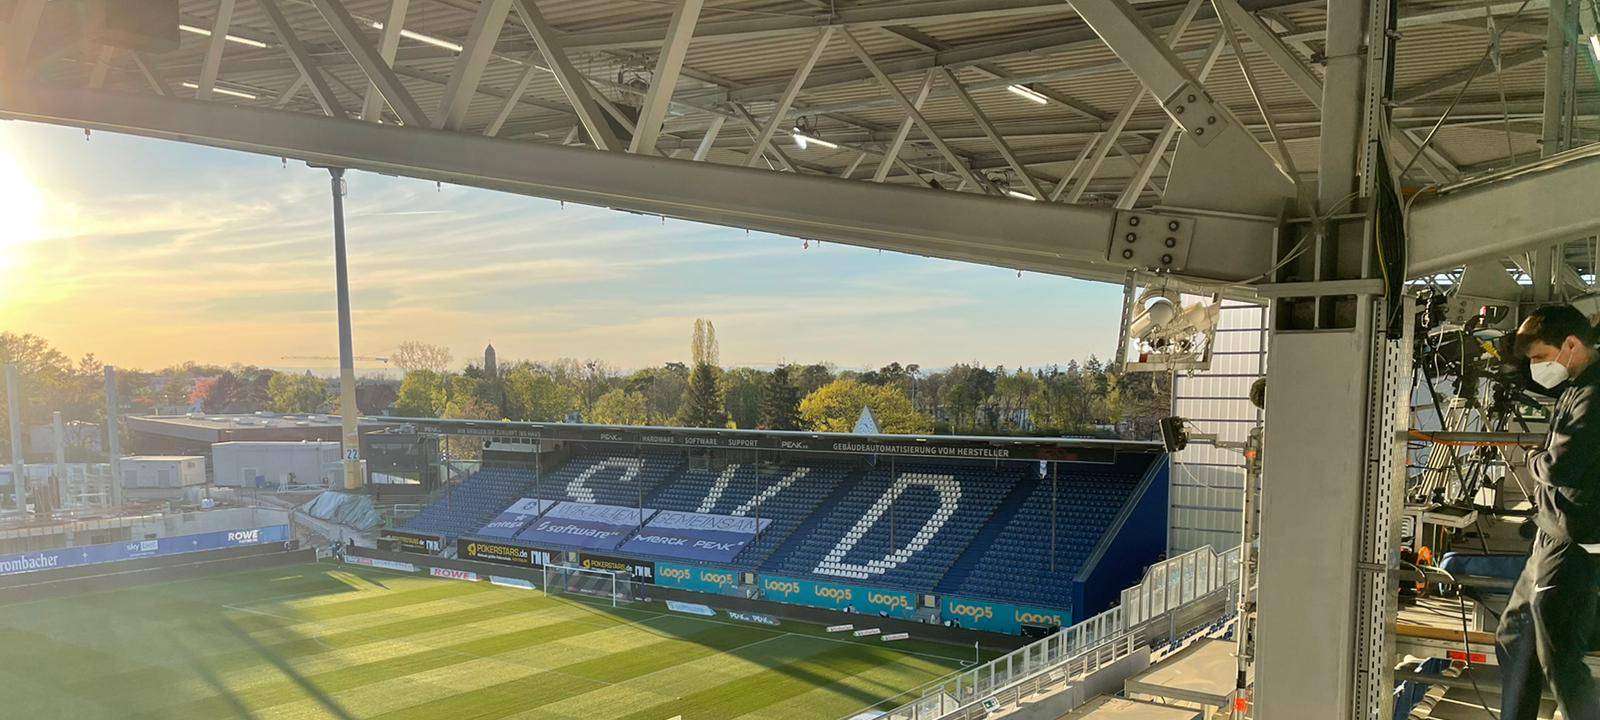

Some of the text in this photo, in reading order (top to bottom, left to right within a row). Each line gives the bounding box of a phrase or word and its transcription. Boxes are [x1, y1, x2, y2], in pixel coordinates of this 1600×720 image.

[642, 435, 675, 443] HARDWARE
[684, 437, 718, 445] SOFTWARE
[728, 439, 758, 447] SUPPORT
[346, 449, 358, 459] 22
[832, 442, 1009, 457] GEBÄUDEAUTOMATISIERUNG VOM HERSTELLER
[228, 529, 260, 541] ROWE
[550, 524, 610, 539] software
[693, 540, 735, 551] PEAK
